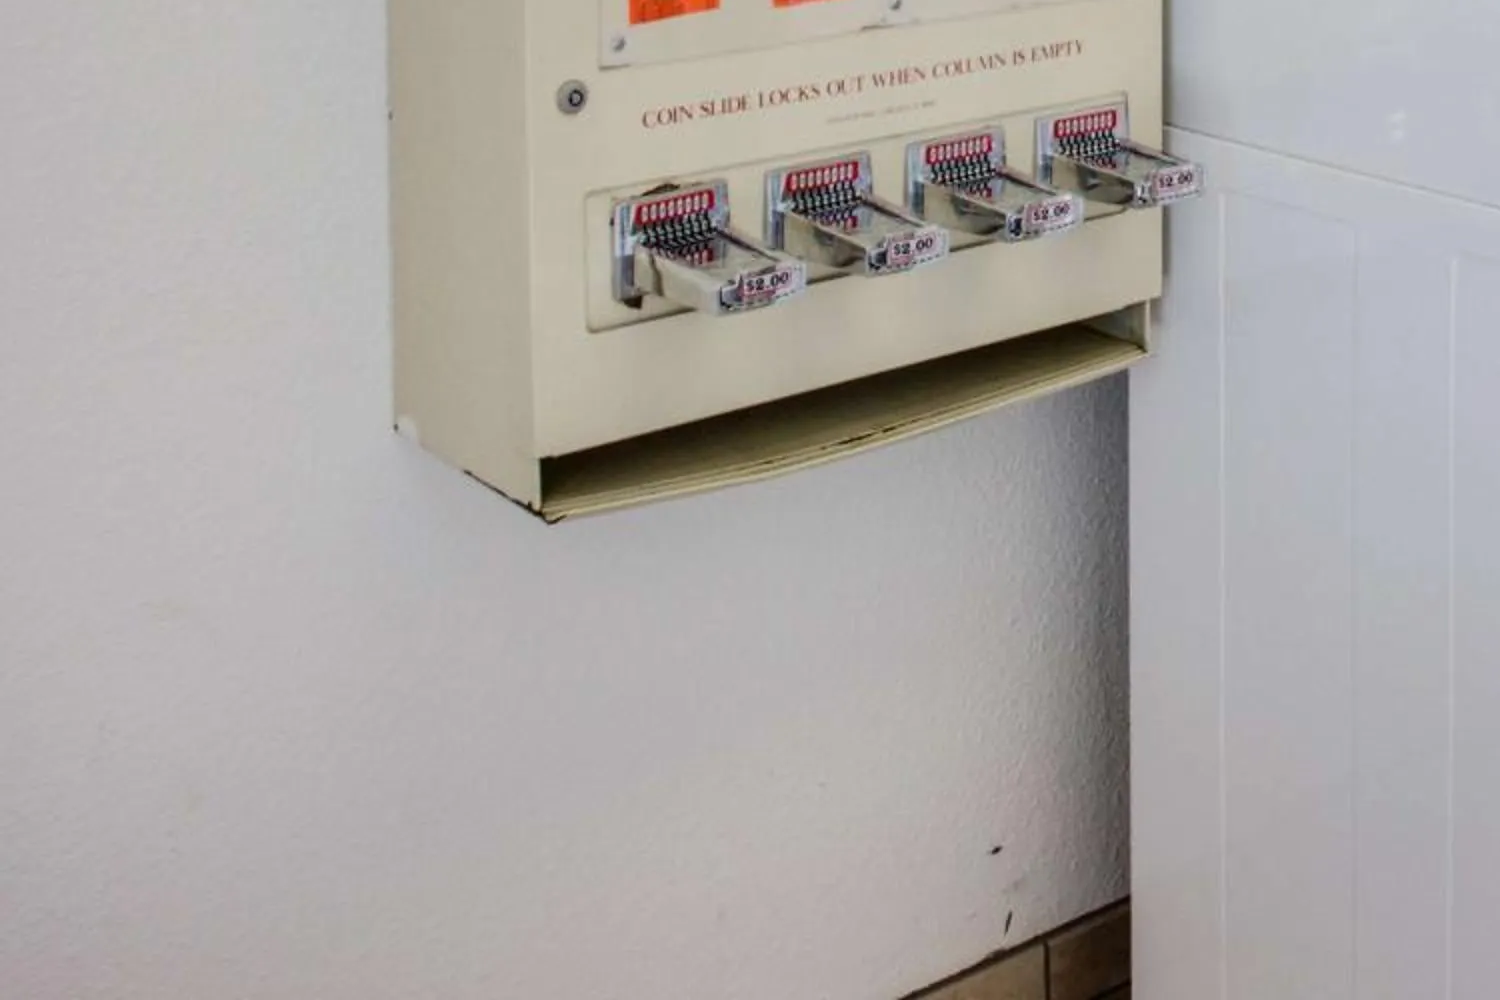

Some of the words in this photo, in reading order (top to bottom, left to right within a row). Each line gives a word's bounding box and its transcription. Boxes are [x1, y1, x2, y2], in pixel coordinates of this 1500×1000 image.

[642, 103, 693, 128] COIN
[699, 95, 752, 117] SLIDE
[758, 83, 821, 108] LOCKS
[826, 74, 865, 97] OUT
[872, 66, 927, 88] WHEN
[932, 53, 1007, 79] COLUMN
[1013, 50, 1026, 66] IS
[1031, 39, 1084, 63] EMPTY
[746, 271, 789, 291] $2.00
